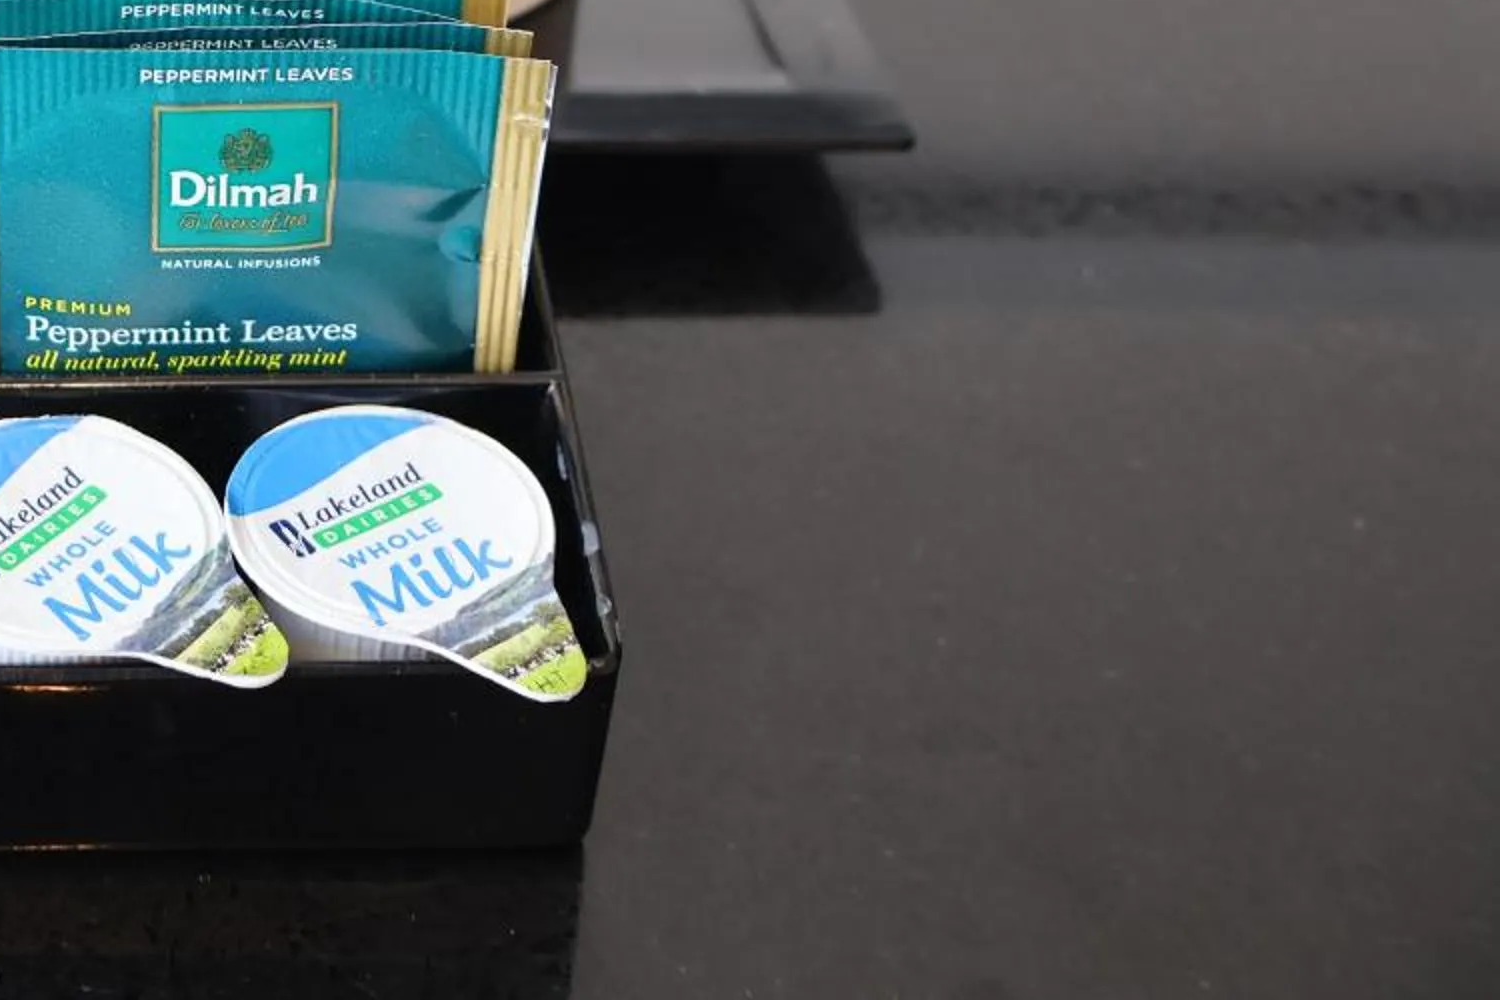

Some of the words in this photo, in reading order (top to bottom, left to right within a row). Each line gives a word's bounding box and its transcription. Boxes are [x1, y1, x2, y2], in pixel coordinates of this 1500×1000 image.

[121, 3, 244, 19] PEPPERMINT
[251, 6, 324, 20] LEAVES
[261, 37, 338, 50] LEAVES
[140, 68, 268, 83] PEPPERMINT
[276, 67, 353, 82] LEAVES
[169, 170, 317, 208] Dilmah
[161, 258, 234, 270] NATURAL
[238, 255, 321, 270] INFUSIONS
[25, 296, 131, 316] PREMIUM
[25, 315, 231, 352] Peppermint
[241, 319, 357, 344] Leaves
[26, 350, 58, 370] all
[65, 352, 160, 372] natural,
[167, 349, 284, 374] sparkling
[289, 348, 348, 367] mint
[297, 462, 424, 530] Lakeland
[2, 491, 99, 566] DAIRIES
[322, 488, 435, 543] DAIRIES
[24, 519, 117, 588] WHOLE
[338, 516, 443, 569] WHOLE
[41, 531, 192, 642] Milk
[351, 537, 514, 627] Milk
